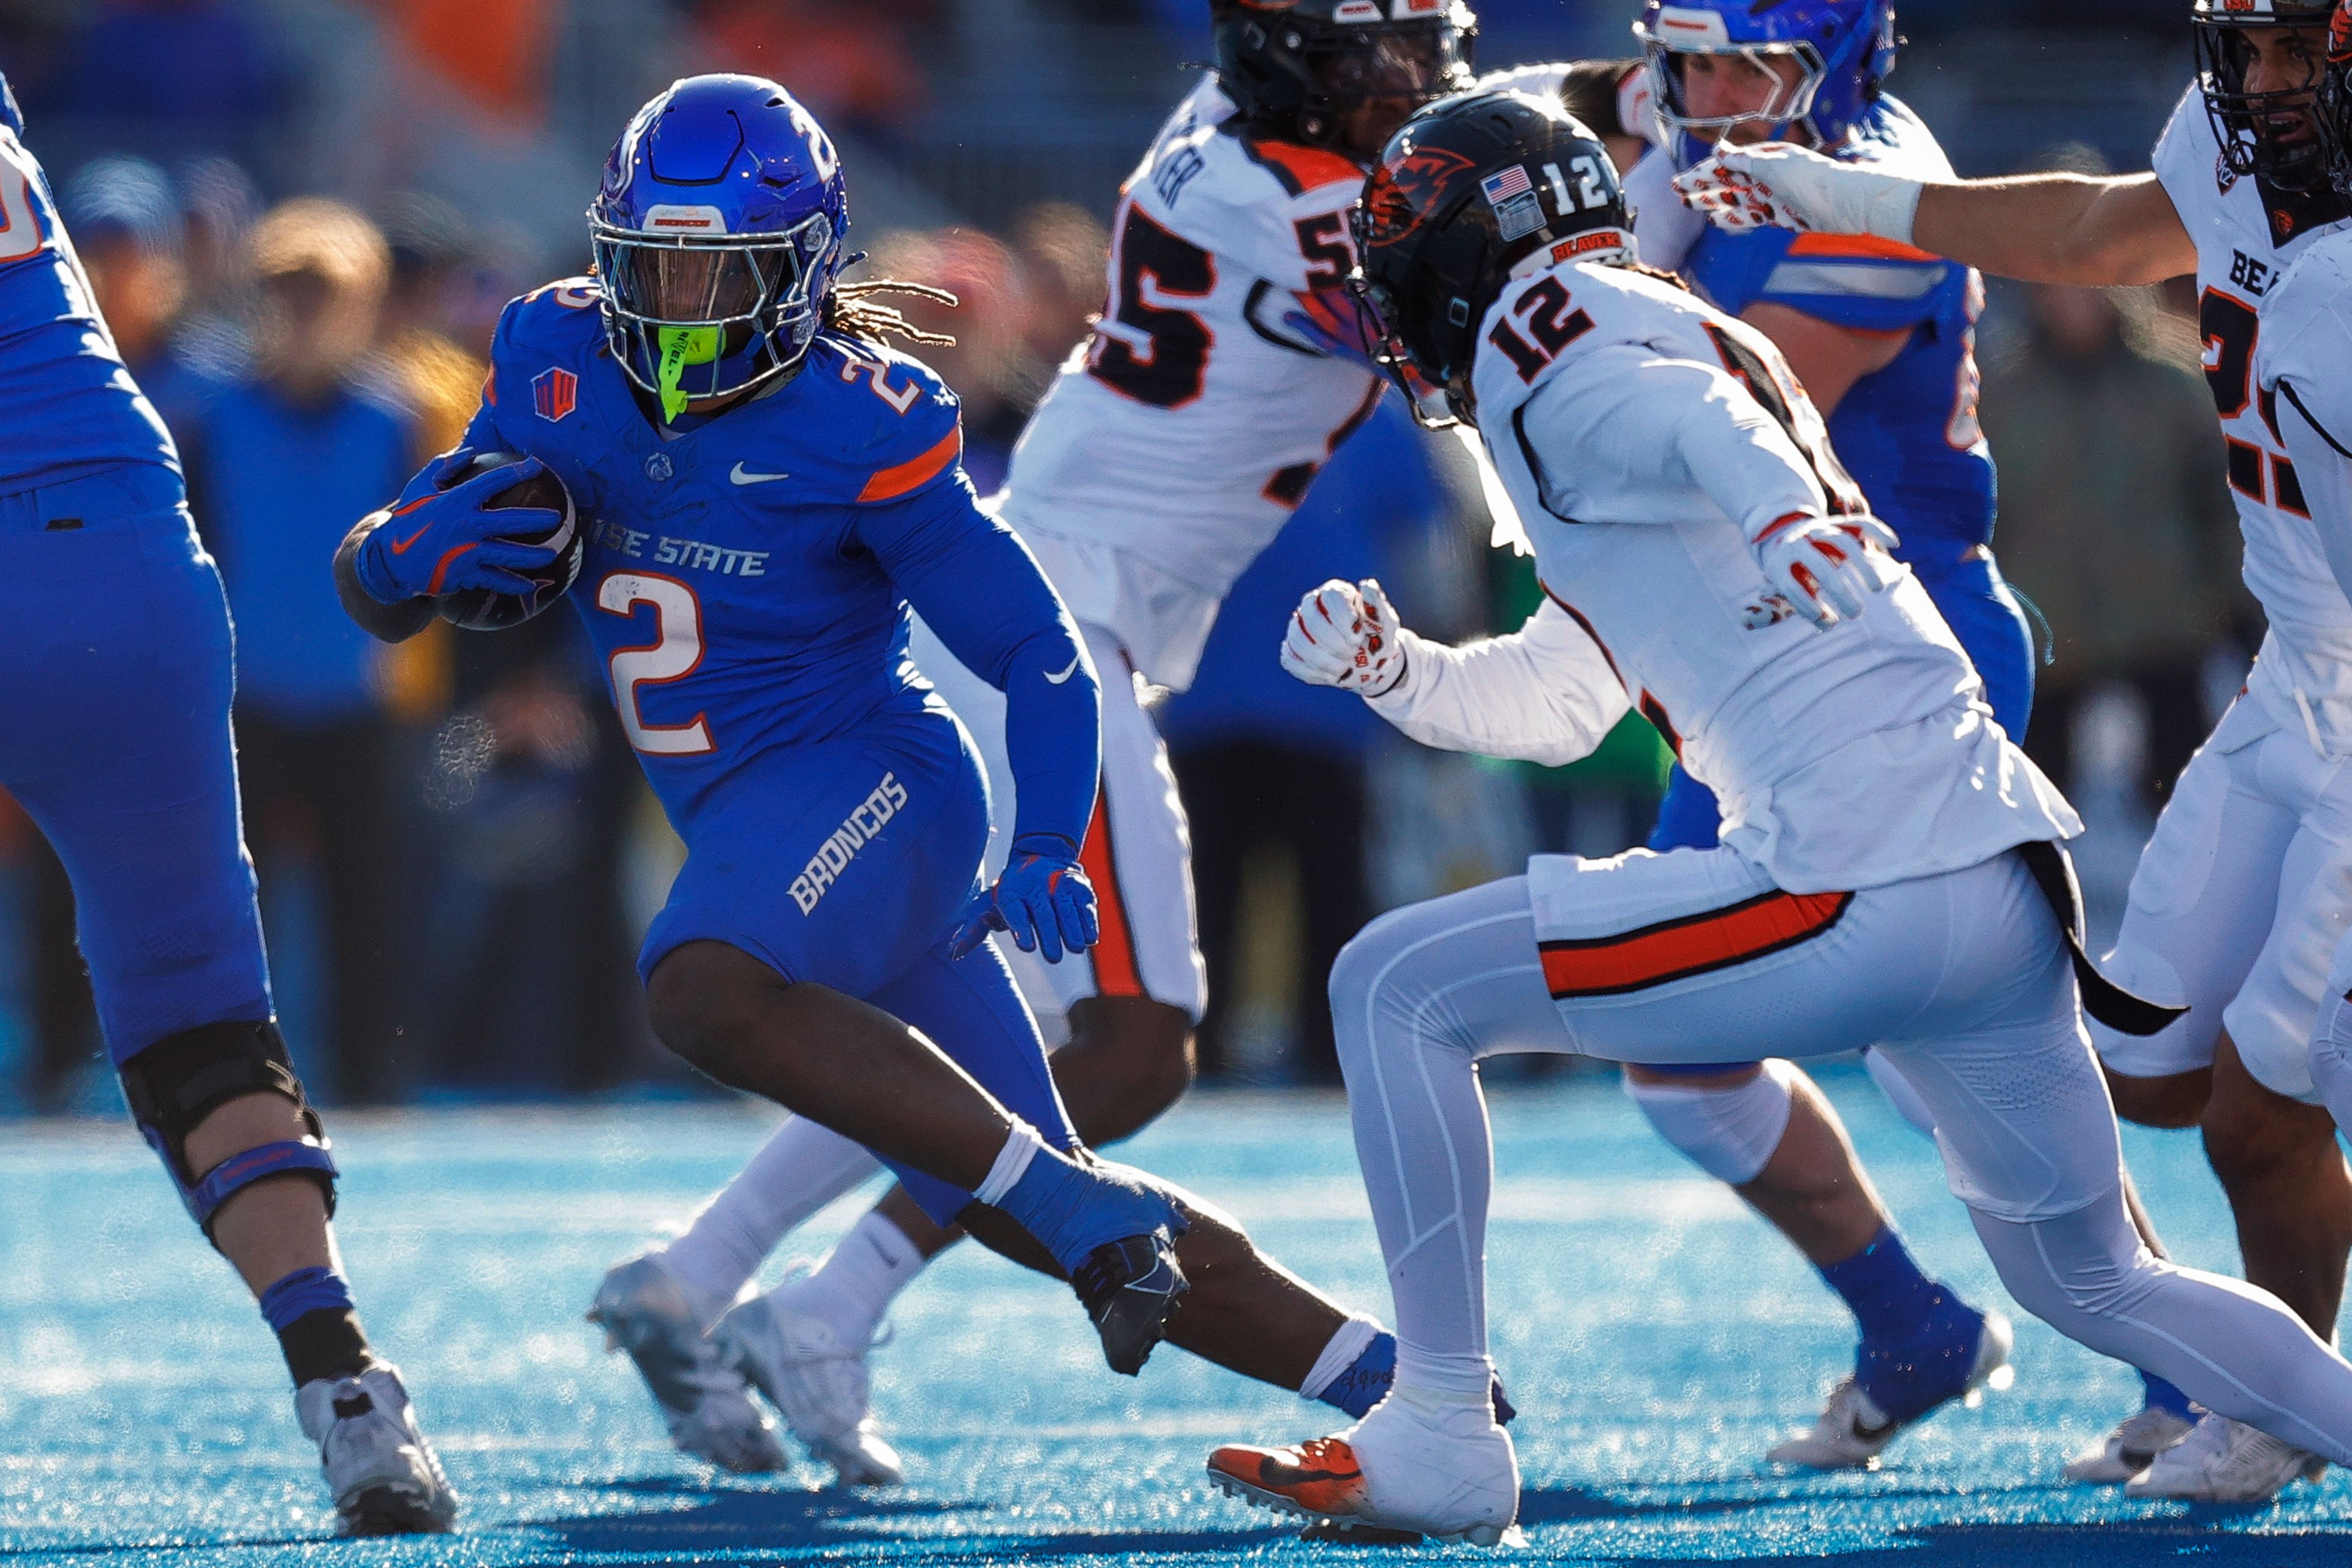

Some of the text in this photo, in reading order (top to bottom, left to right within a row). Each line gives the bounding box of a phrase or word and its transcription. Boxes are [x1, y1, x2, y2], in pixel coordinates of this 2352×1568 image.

[1542, 154, 1609, 216] 12
[1488, 275, 1596, 386] 12
[841, 358, 922, 417] 2
[581, 516, 770, 576] ISE STATE
[595, 568, 719, 756] 2
[785, 771, 908, 917] BRONCOS
